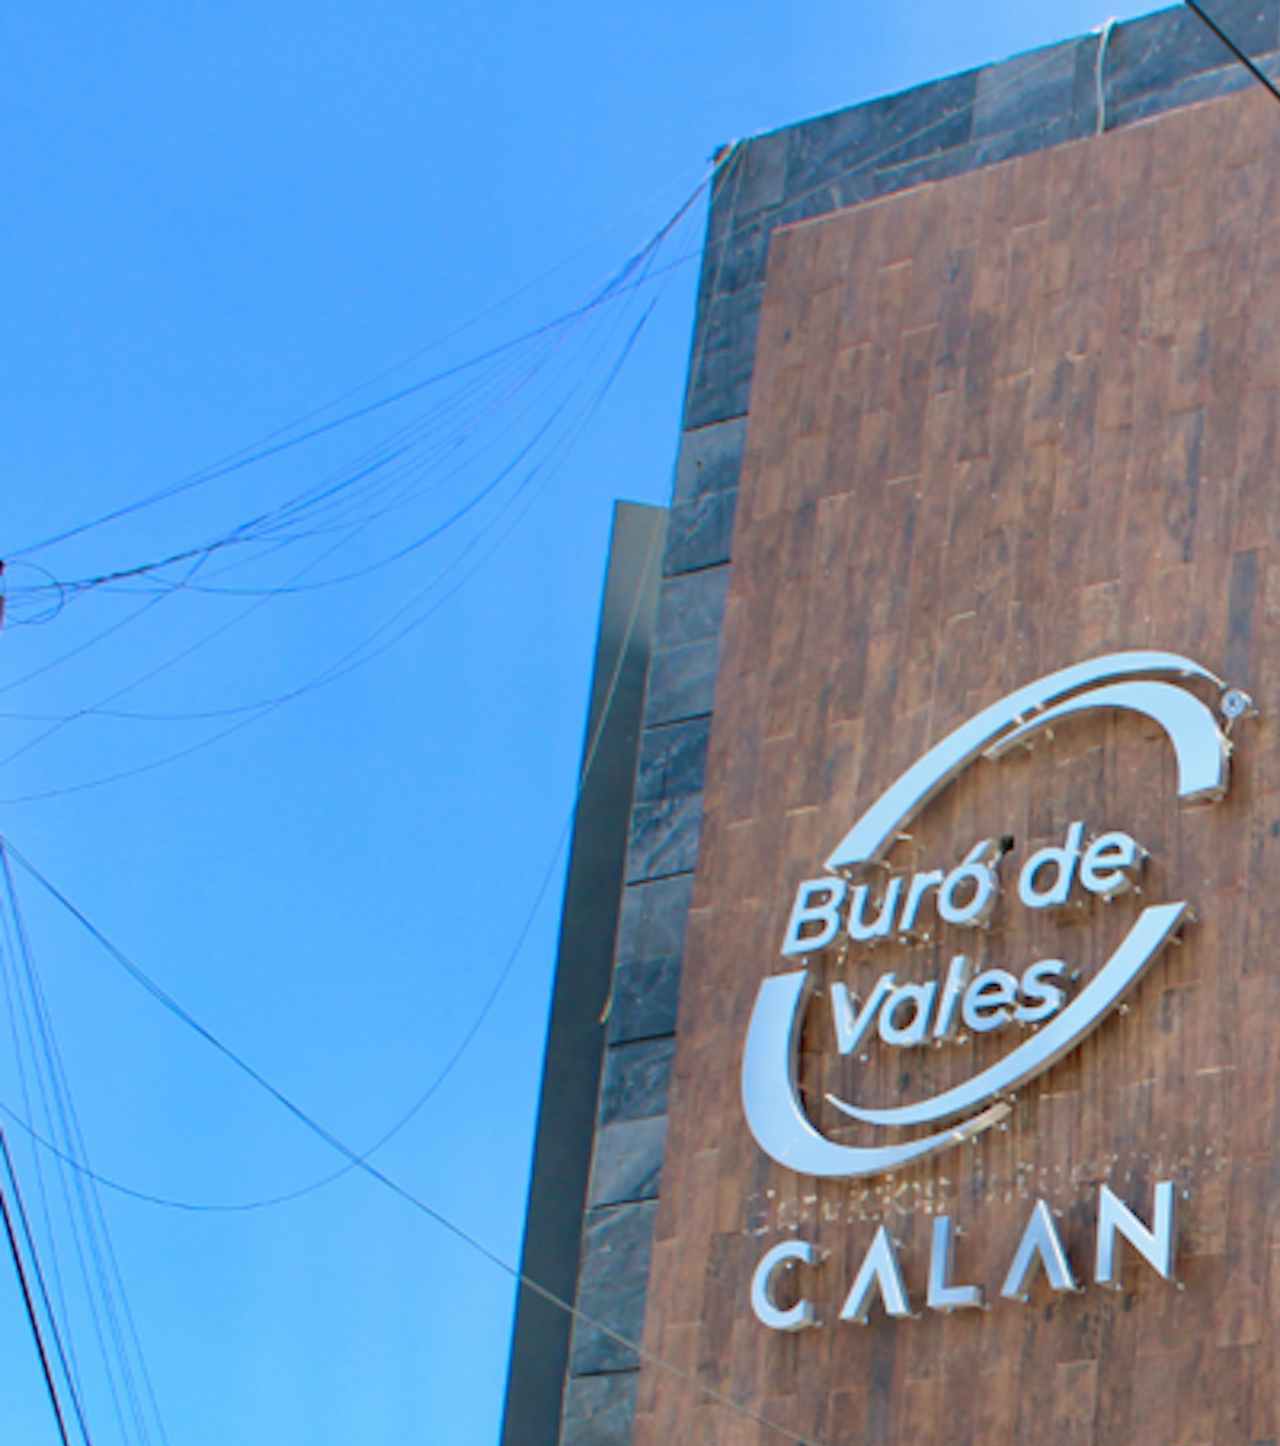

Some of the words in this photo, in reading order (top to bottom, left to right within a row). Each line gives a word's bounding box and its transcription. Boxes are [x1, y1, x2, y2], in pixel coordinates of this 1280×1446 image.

[781, 841, 997, 957] Buró
[1017, 821, 1140, 909] de
[830, 955, 1068, 1055] Vales
[750, 1180, 1175, 1332] CALAN
